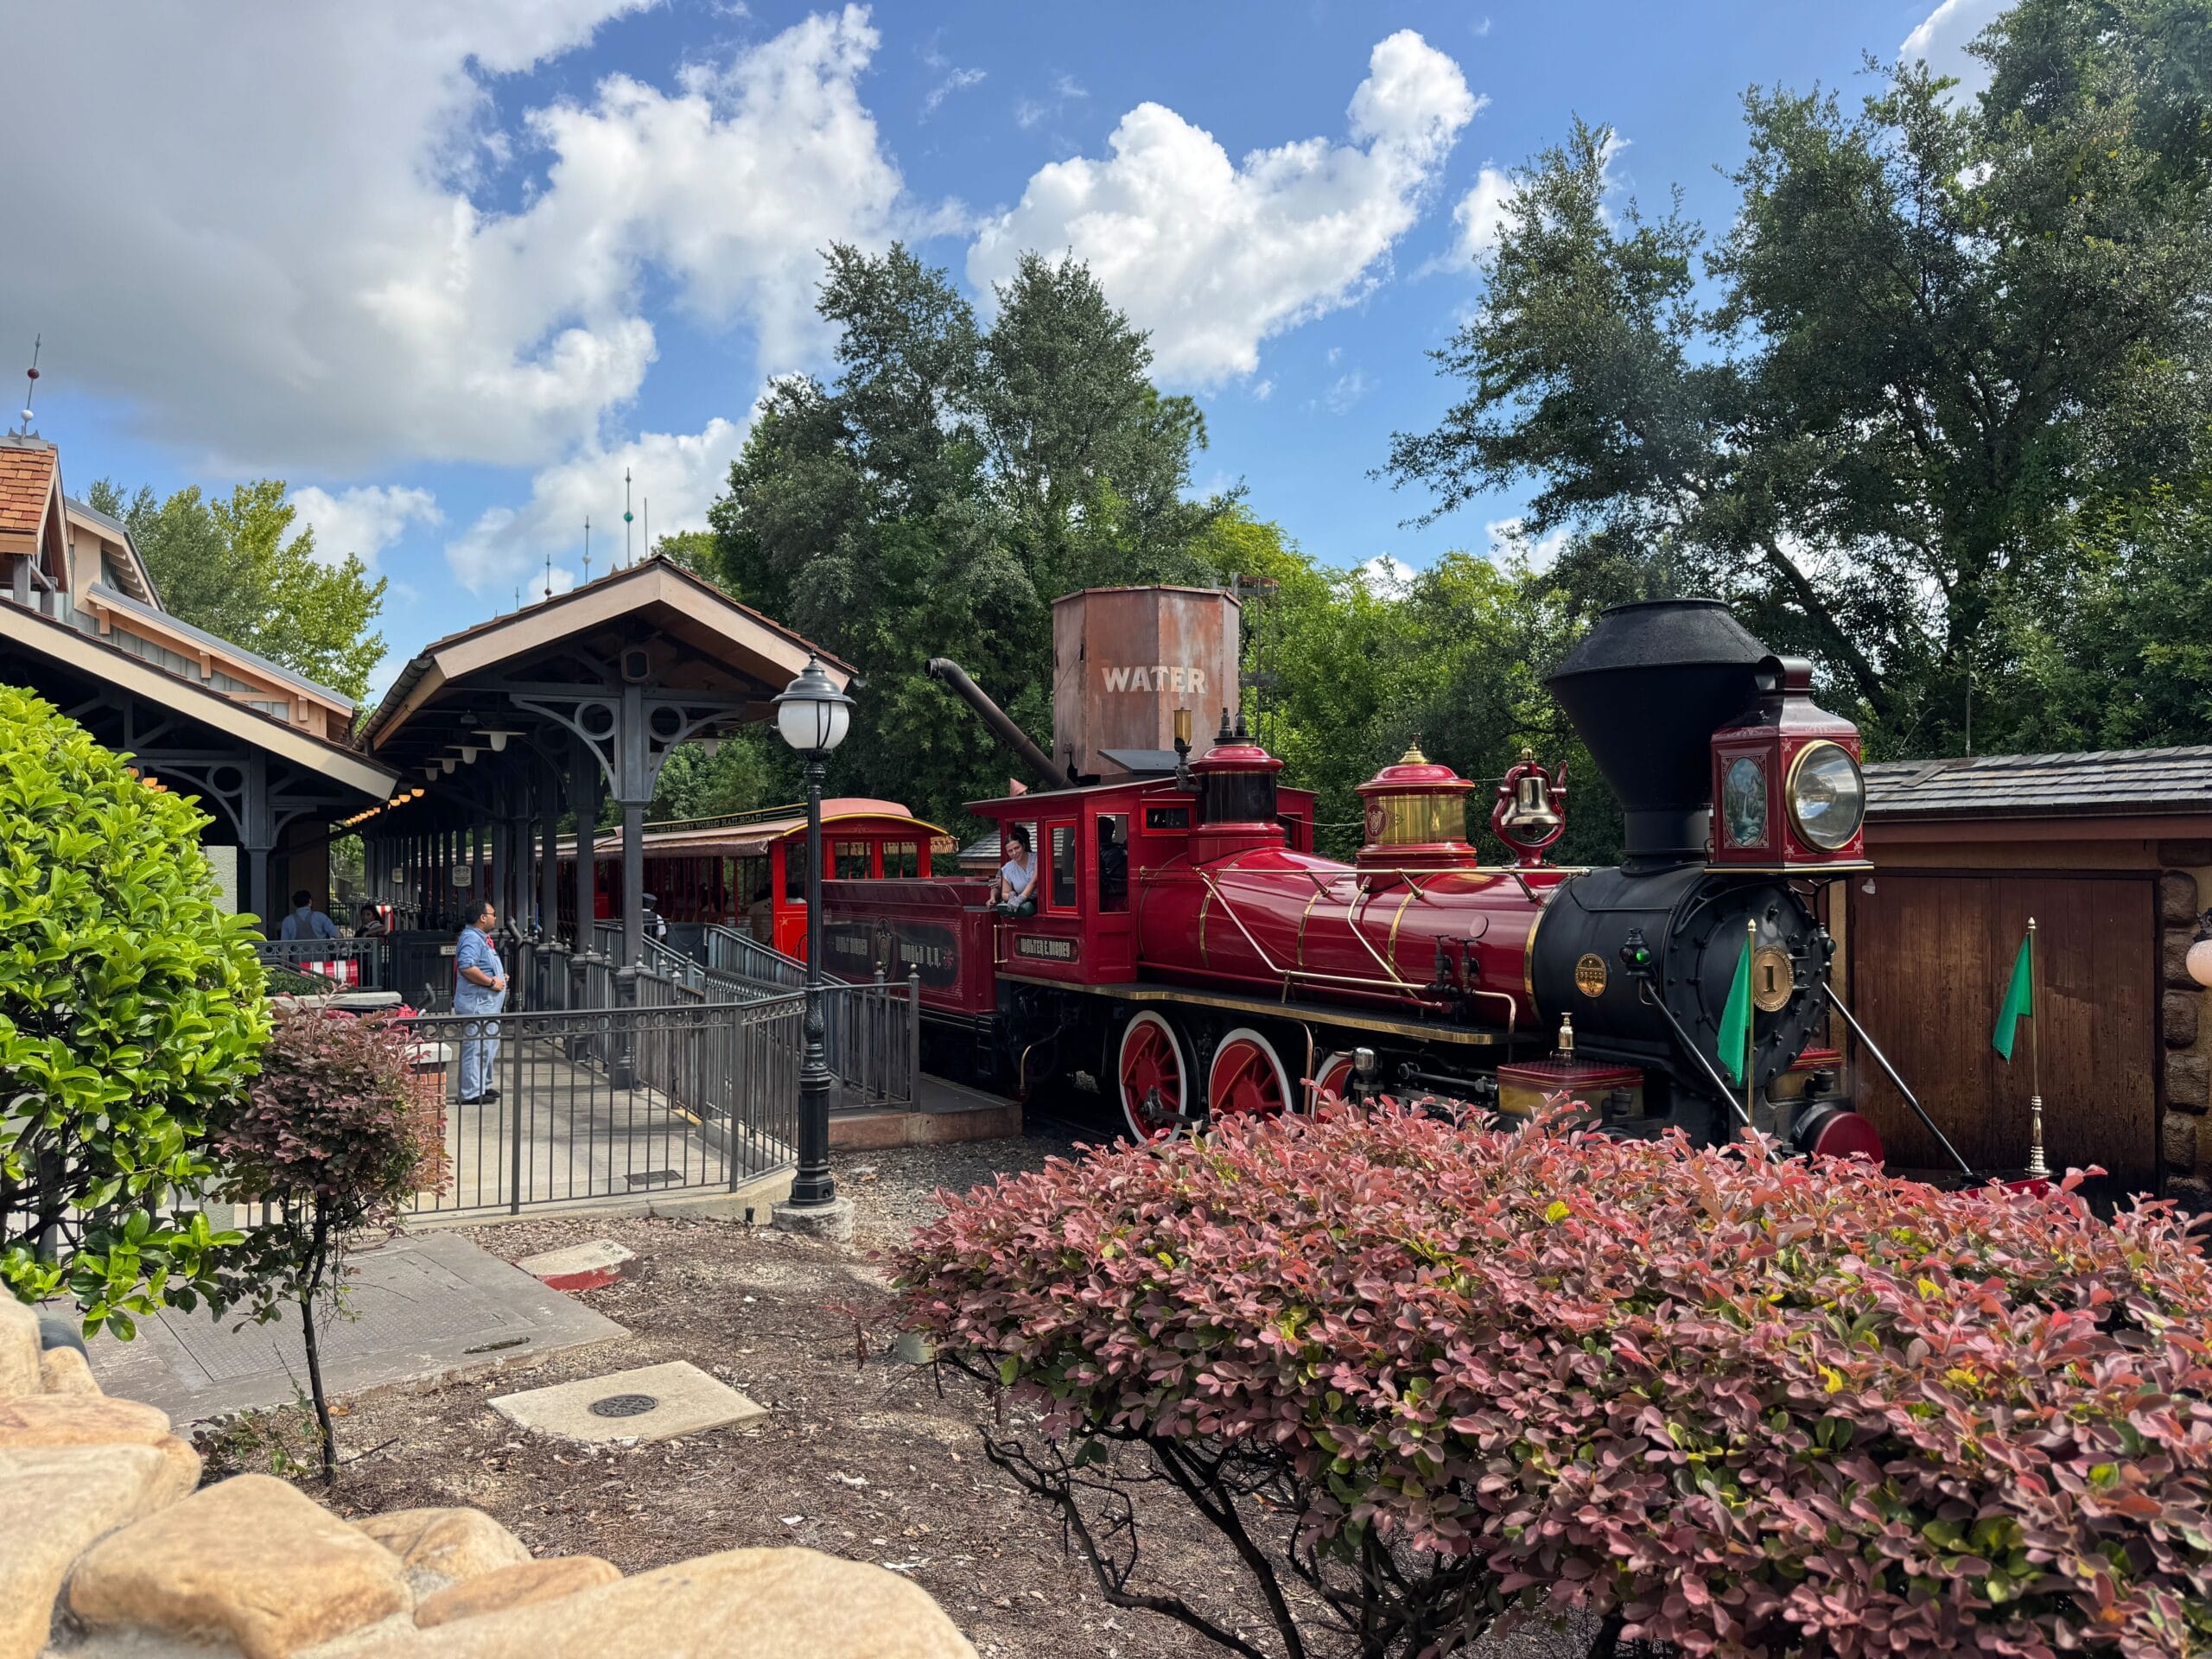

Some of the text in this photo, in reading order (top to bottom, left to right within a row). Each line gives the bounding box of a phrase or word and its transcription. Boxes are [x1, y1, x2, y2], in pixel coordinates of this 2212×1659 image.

[1101, 665, 1206, 694] WATER
[671, 822, 695, 832] DISNEY
[696, 820, 721, 830] WORLD
[721, 813, 762, 827] RAILROAD
[900, 944, 924, 963] WORLD
[1020, 938, 1044, 956] WALTER
